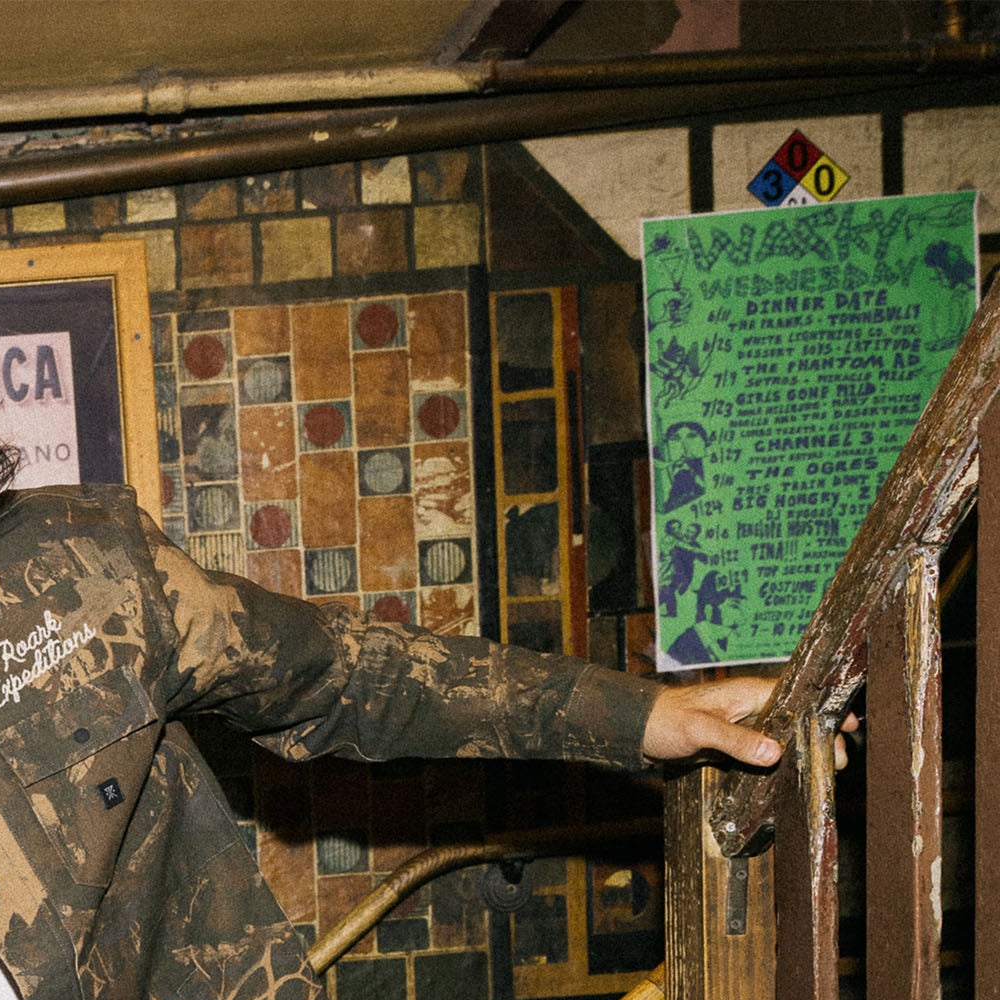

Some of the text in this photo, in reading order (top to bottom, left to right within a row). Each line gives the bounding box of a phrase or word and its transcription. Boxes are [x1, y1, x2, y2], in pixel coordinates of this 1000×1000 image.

[788, 141, 807, 172] 0
[763, 169, 783, 201] 3
[814, 164, 835, 196] 0
[698, 256, 917, 299] WEDNESDAY
[746, 288, 888, 316] DINNER DATE
[844, 337, 922, 355] LATITUDE
[742, 352, 921, 375] THE PHANTOM AD
[736, 390, 781, 406] GIRLS
[786, 385, 829, 402] GONE
[833, 403, 920, 420] DESERTERS
[754, 435, 851, 453] CHANNEL
[859, 431, 874, 446] 3
[745, 458, 880, 480] THE OGRES
[736, 483, 771, 495] THIS
[781, 477, 826, 492] TRAIN
[731, 494, 768, 511] BIG
[782, 562, 832, 576] SECRET
[759, 578, 817, 598] COSTUME
